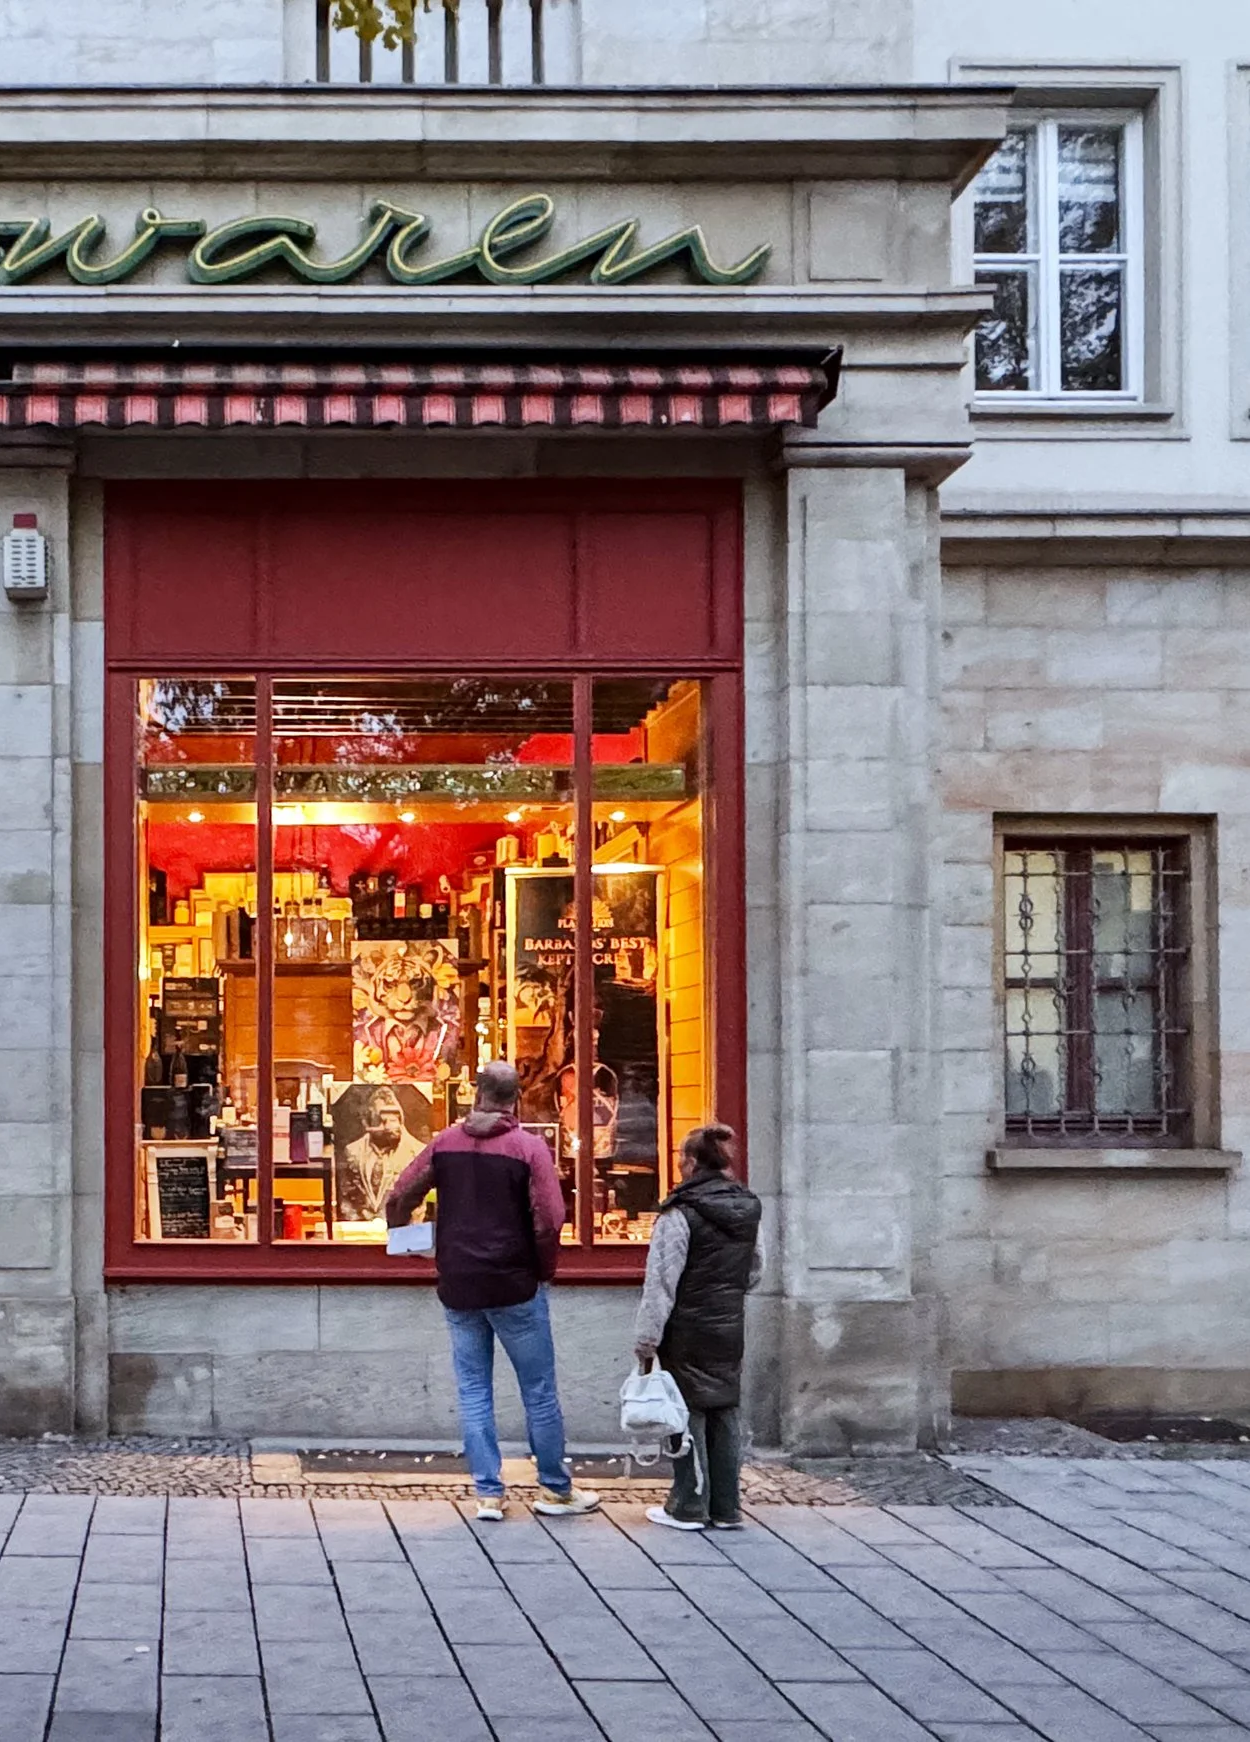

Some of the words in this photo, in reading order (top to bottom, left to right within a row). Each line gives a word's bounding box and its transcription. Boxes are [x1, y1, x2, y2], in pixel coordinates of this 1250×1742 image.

[557, 918, 614, 929] PLATION
[525, 937, 607, 950] BARBAS'
[610, 936, 649, 950] BEST
[537, 954, 575, 966] KEPT
[592, 953, 632, 966] CRET
